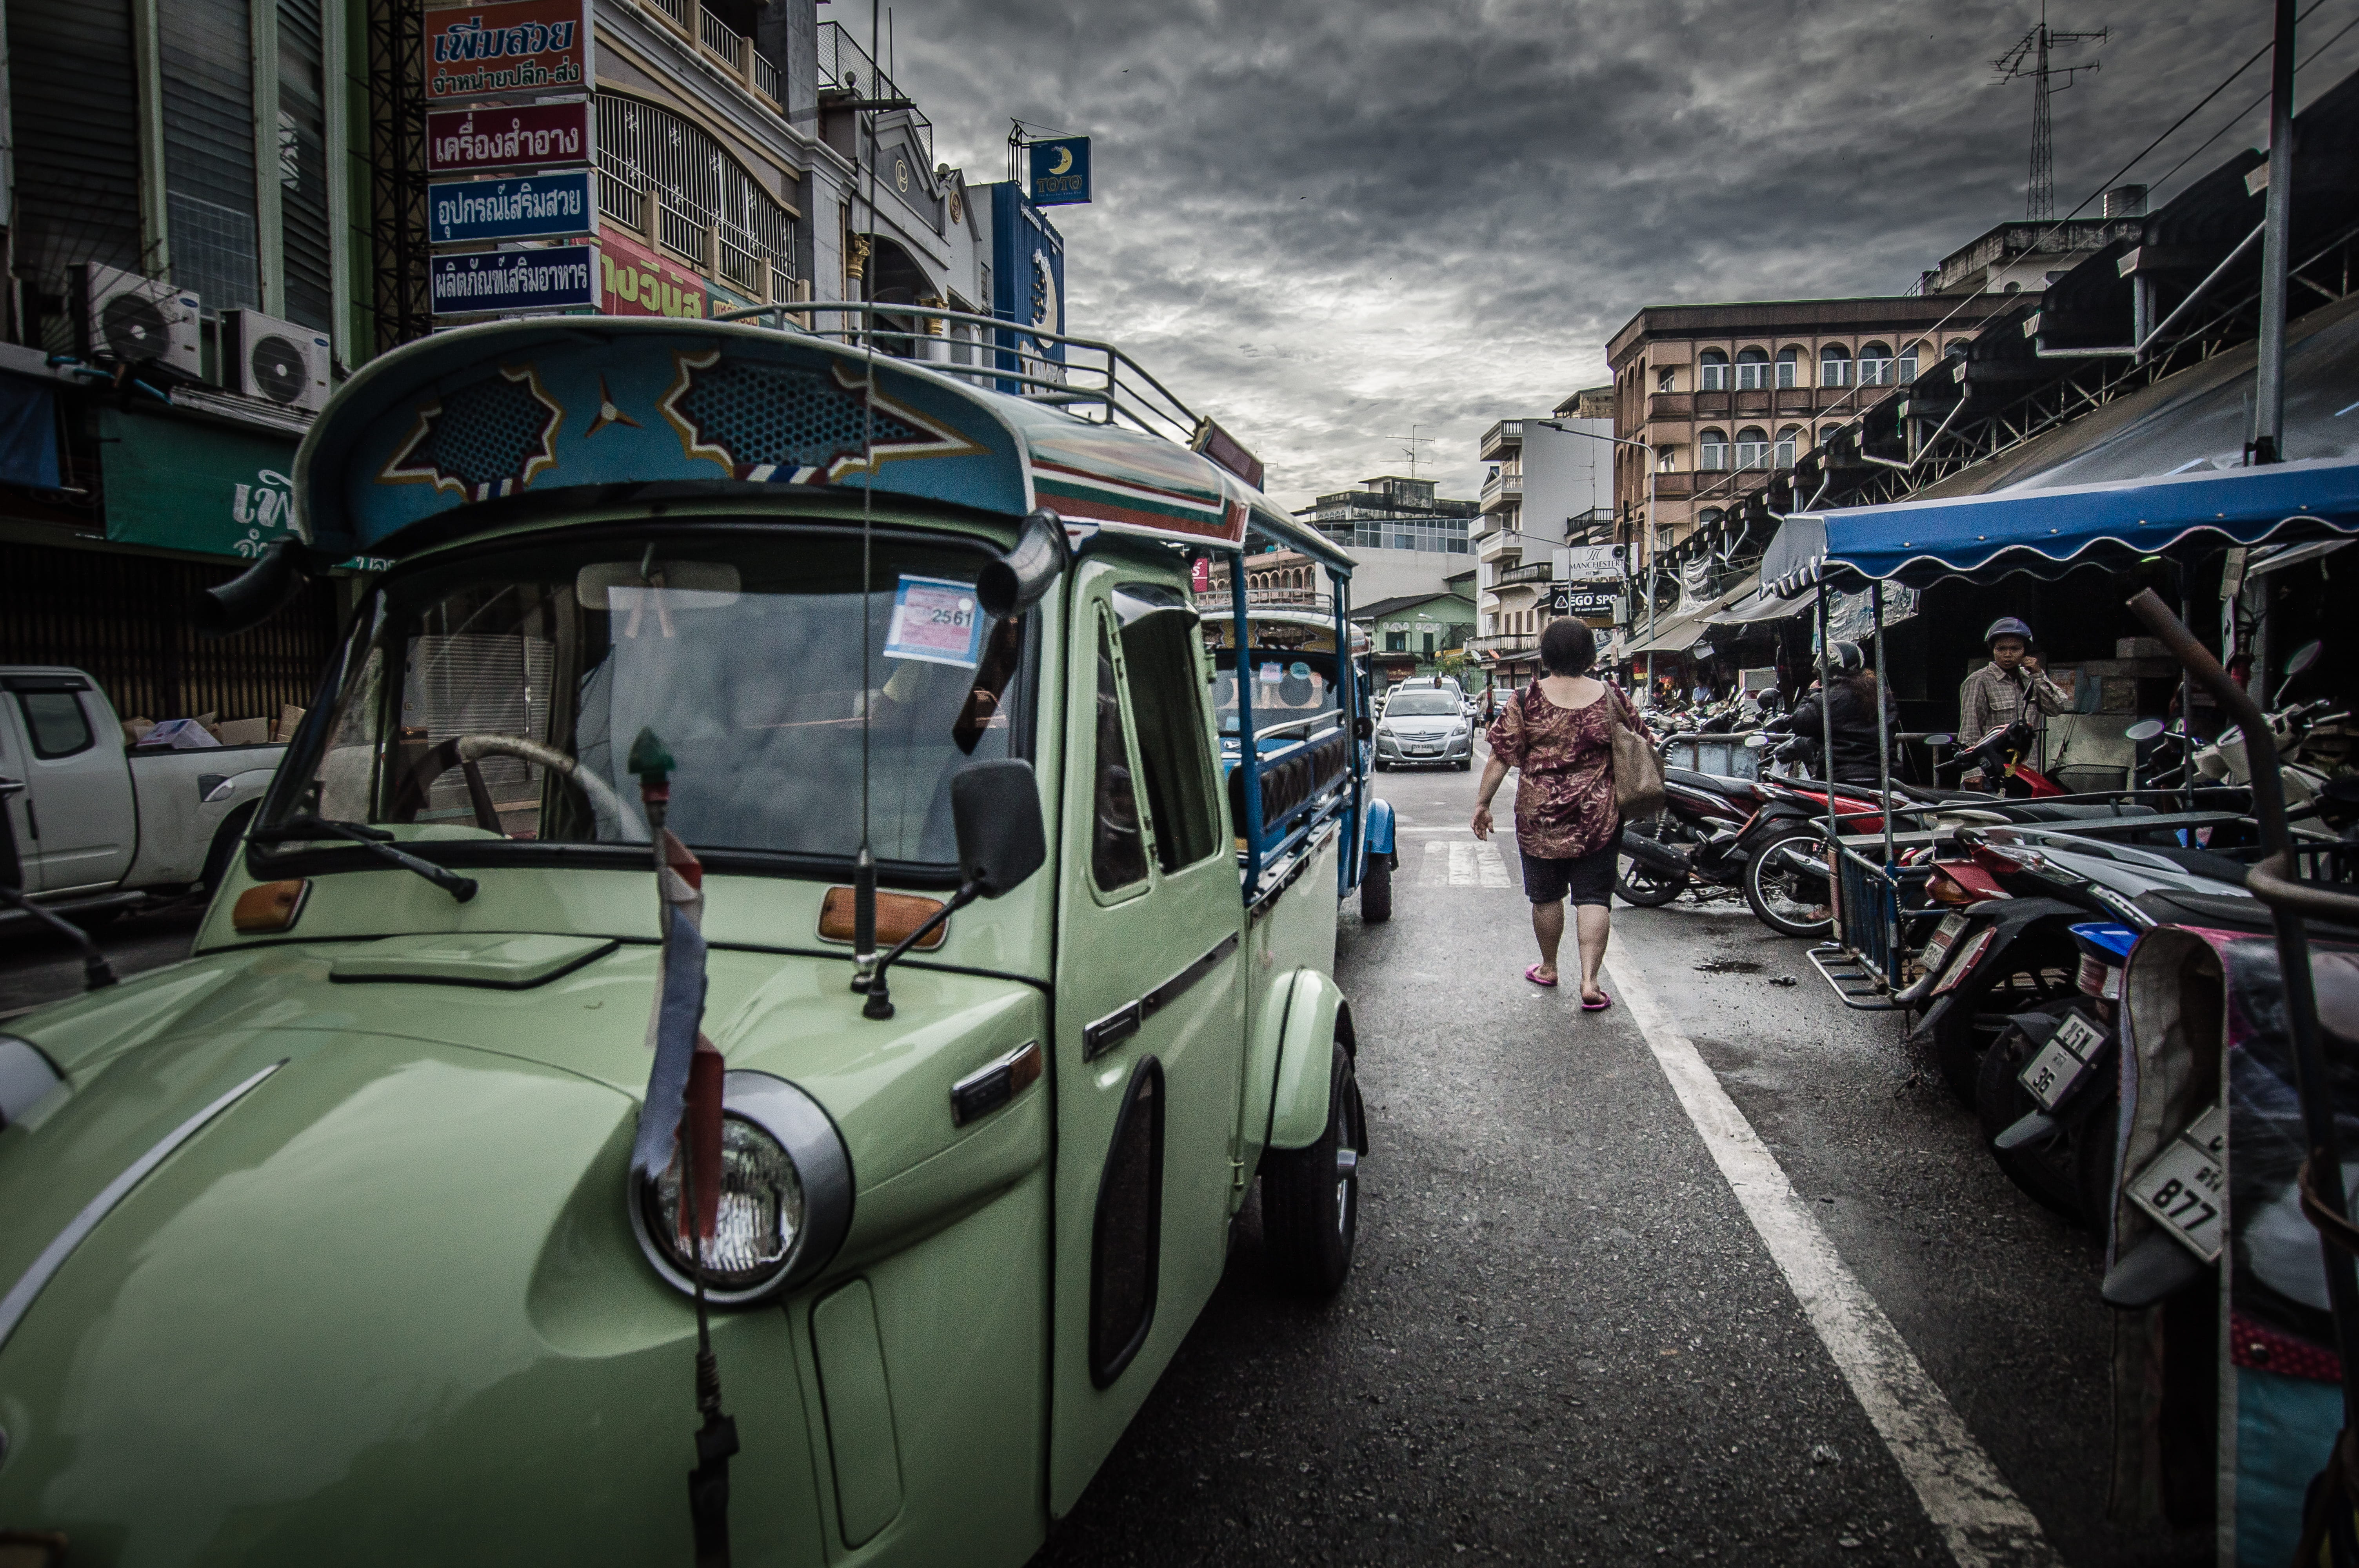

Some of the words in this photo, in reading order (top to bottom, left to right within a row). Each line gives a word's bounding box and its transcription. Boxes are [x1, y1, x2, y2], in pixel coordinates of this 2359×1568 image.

[433, 16, 576, 64] เพิ่มสวย
[433, 56, 580, 94] จำหน่ายปลีก-ส่ง
[436, 113, 578, 163] เครื่องสำอาง
[1037, 175, 1082, 193] TOTO
[439, 182, 580, 238] อุปกรณ์เสริมสวย
[436, 256, 587, 298] ผลิตภัณฑ์เสริมอาหาร
[1570, 560, 1620, 569] MANCHESTER
[932, 609, 972, 627] 2561
[1596, 594, 1617, 604] SPO
[2153, 1178, 2217, 1230] 877
